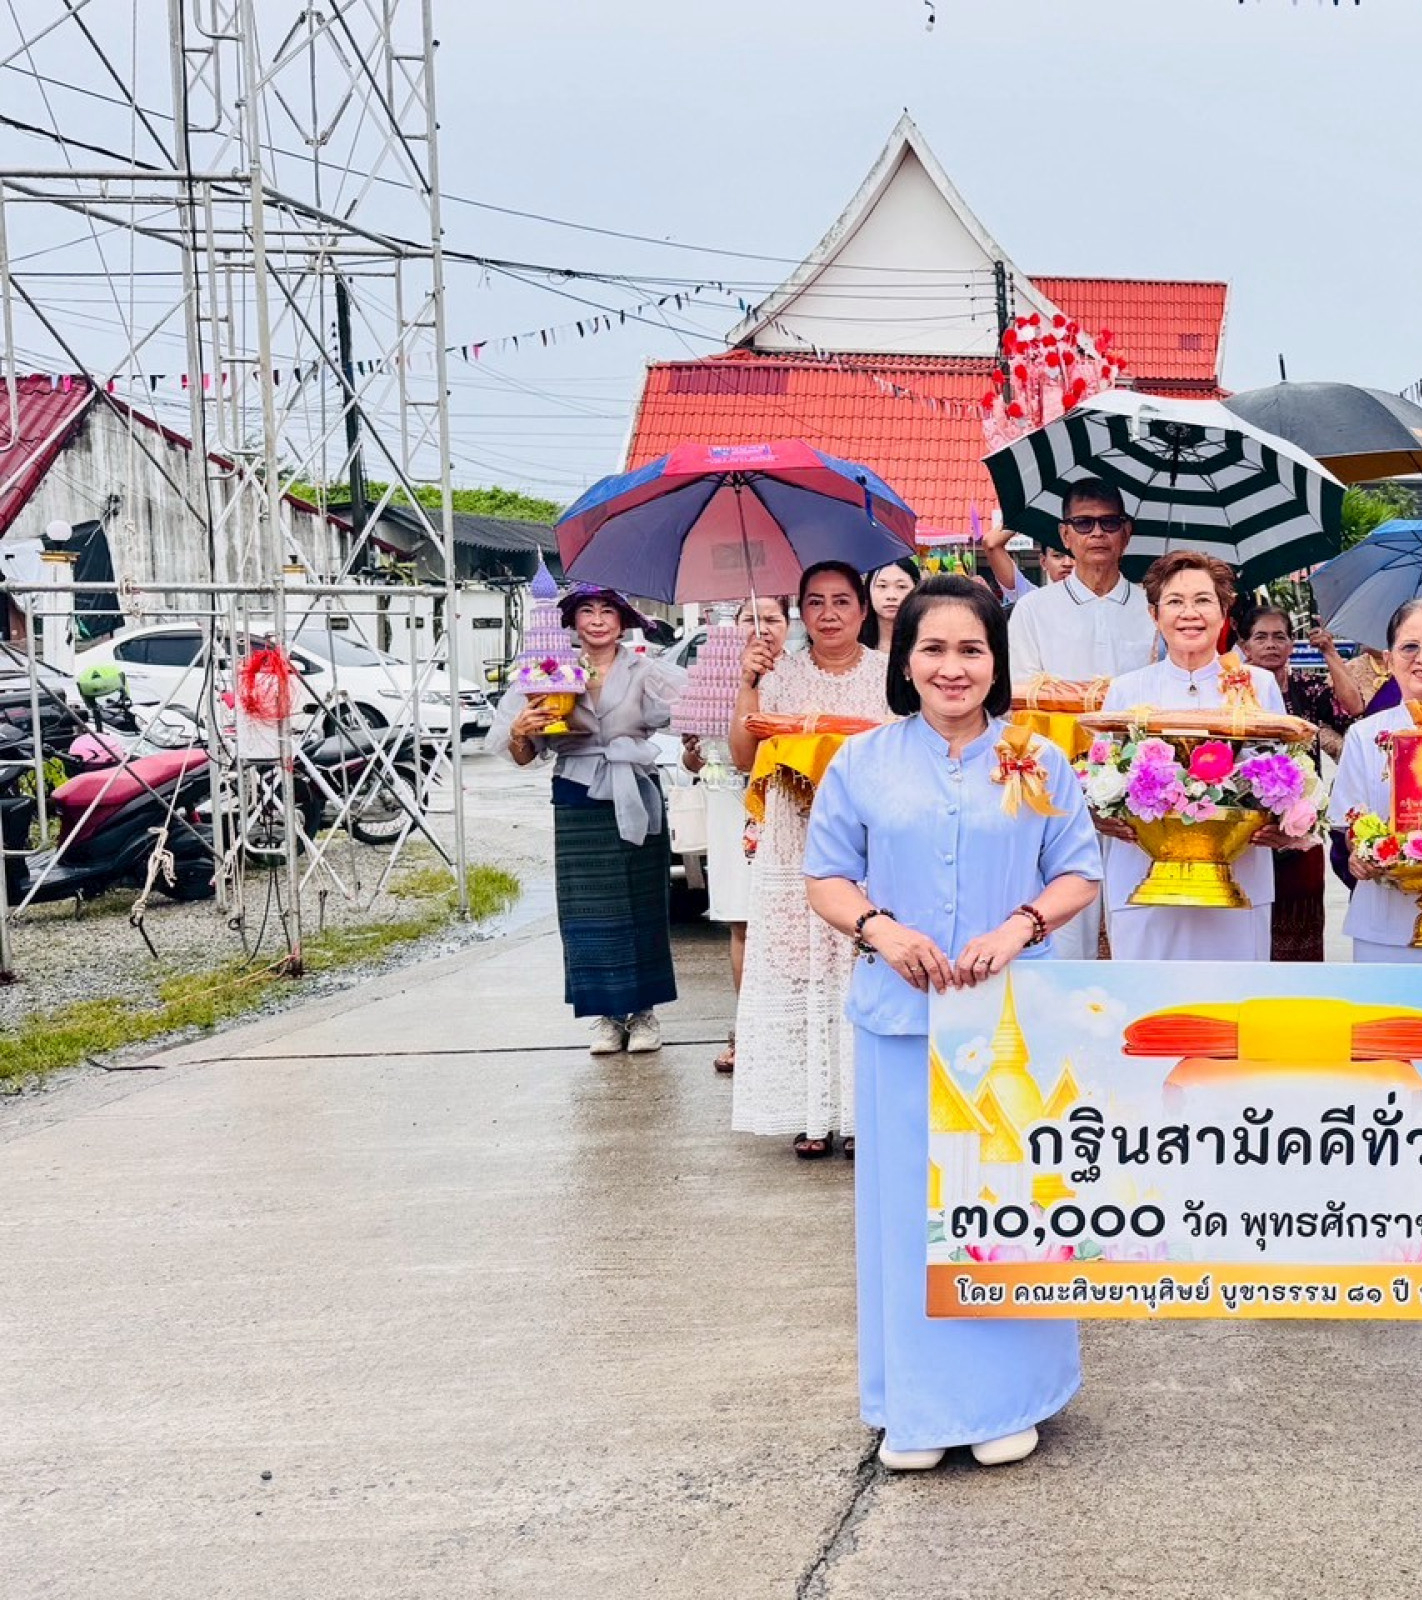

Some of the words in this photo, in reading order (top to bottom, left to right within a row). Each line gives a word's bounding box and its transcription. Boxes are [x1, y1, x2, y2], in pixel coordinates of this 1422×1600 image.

[951, 1204, 1166, 1246] ๓๐,๐๐๐
[1182, 1199, 1227, 1237] วัด
[956, 1277, 1004, 1302] โดย
[1014, 1275, 1210, 1309] คณะศิษยานุศิษย์
[1220, 1284, 1337, 1310] บูชาธรรม
[1347, 1286, 1383, 1303] ๘๑
[1391, 1278, 1410, 1303] ปี
